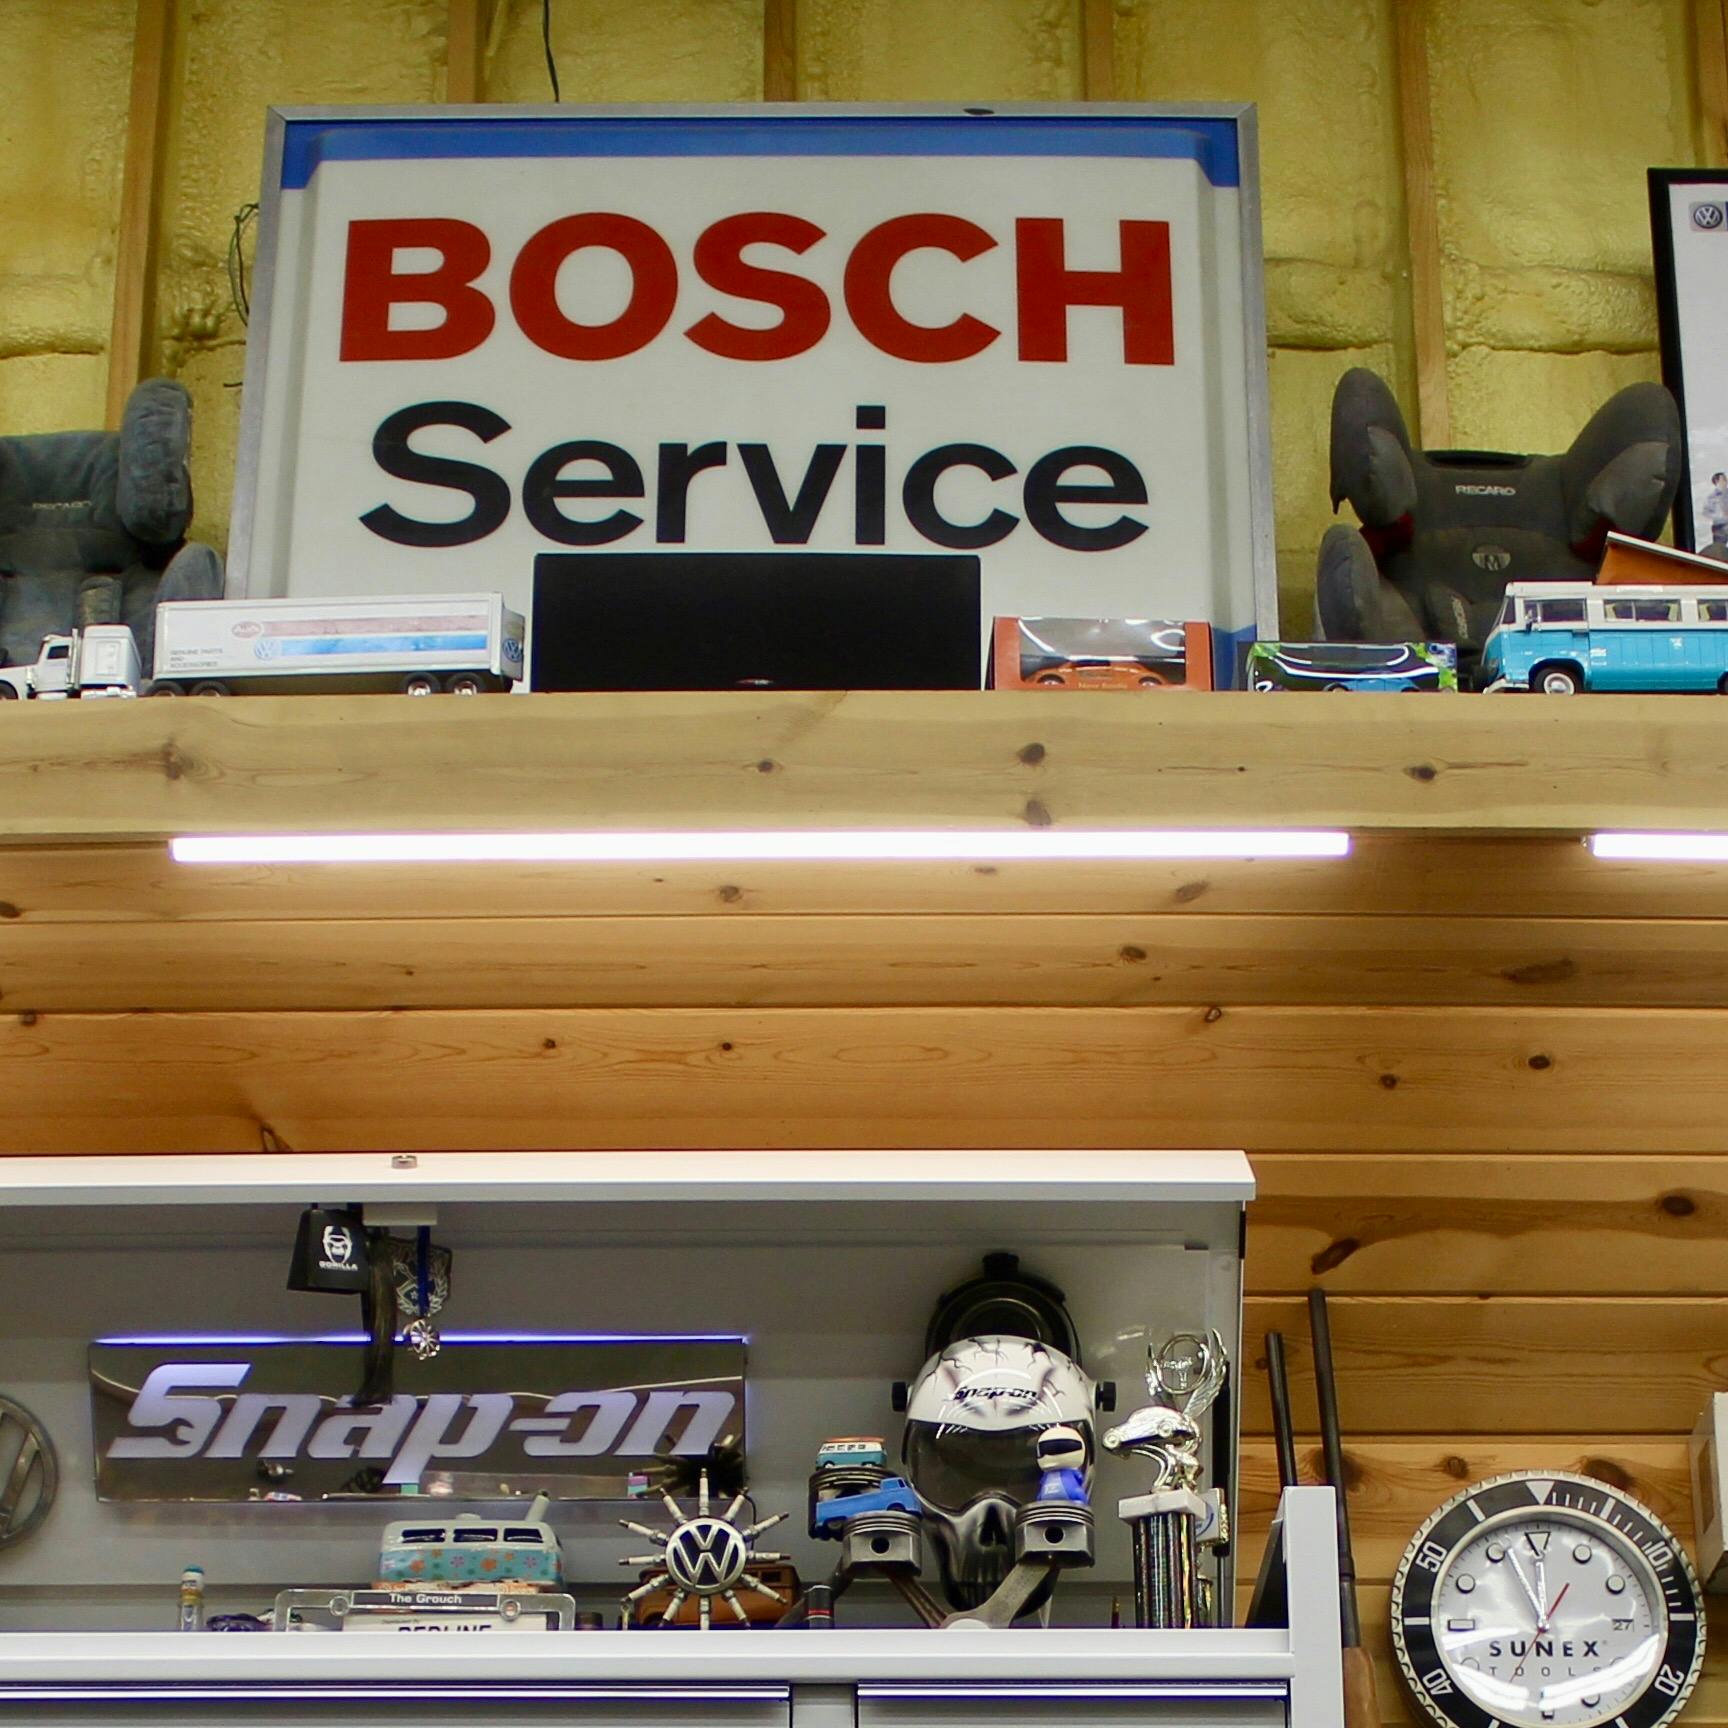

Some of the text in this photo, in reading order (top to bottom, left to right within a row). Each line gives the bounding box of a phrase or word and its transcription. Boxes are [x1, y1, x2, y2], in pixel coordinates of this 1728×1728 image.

[338, 211, 1176, 366] BOSCH
[358, 400, 1151, 552] Service
[1455, 484, 1516, 497] RECARO
[319, 1260, 359, 1272] GORILLA
[953, 1385, 1040, 1401] Snap-on
[106, 1362, 738, 1485] Snap-on
[1415, 1541, 1447, 1573] 50
[1642, 1541, 1673, 1567] 10
[389, 1593, 462, 1606] The Grouch
[1489, 1640, 1600, 1658] SUNEX
[1422, 1668, 1453, 1695] 40
[1654, 1664, 1684, 1695] 20
